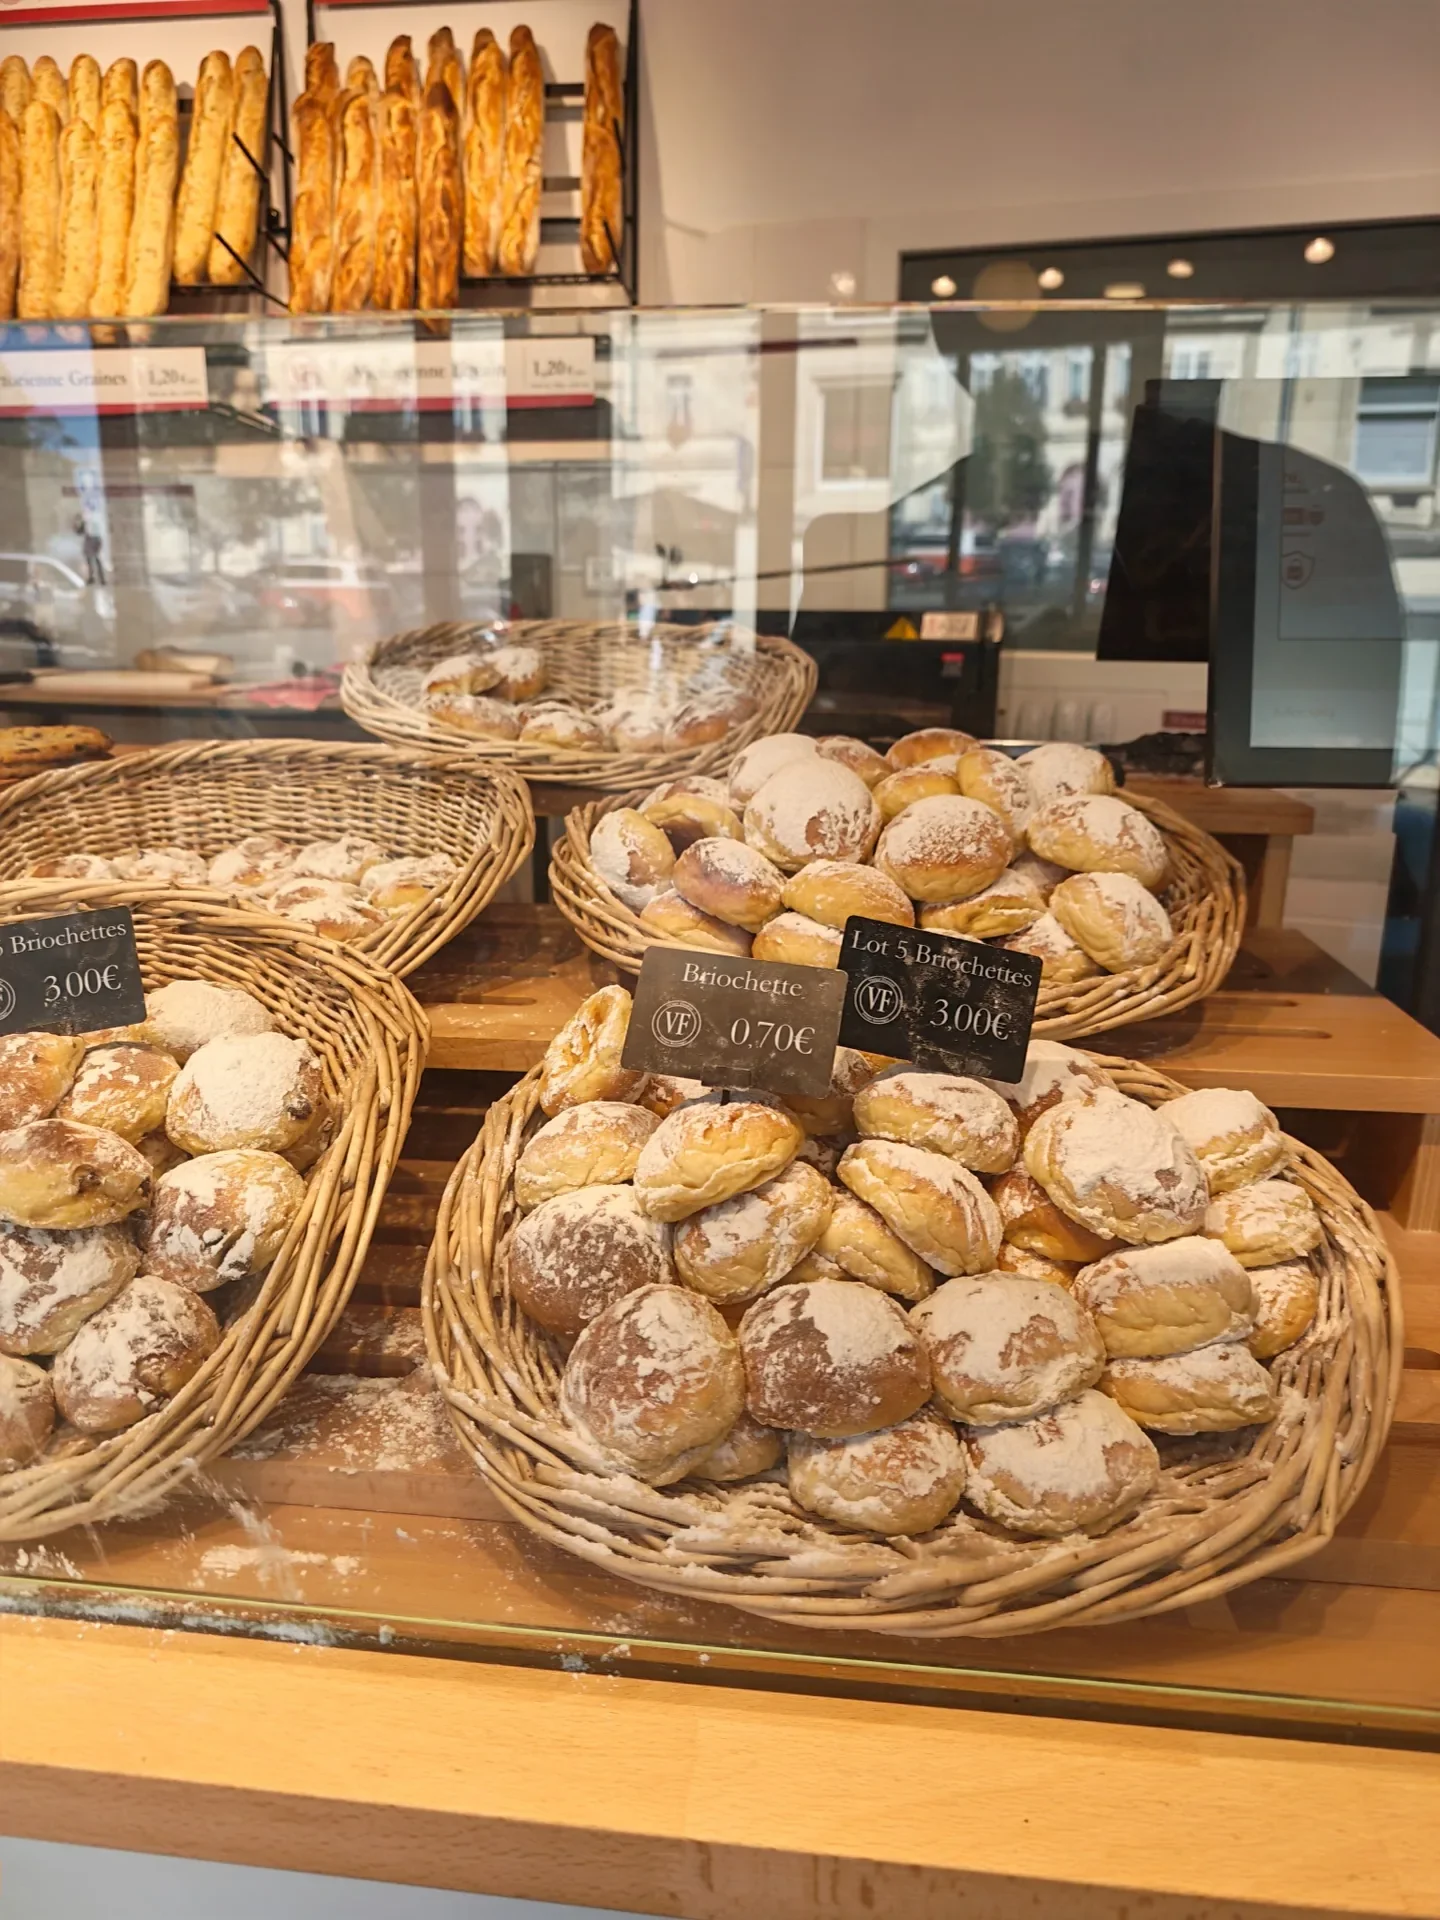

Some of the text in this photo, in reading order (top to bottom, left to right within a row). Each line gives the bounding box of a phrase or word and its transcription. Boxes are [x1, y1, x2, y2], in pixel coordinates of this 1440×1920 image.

[9, 923, 127, 955] Briochettes
[851, 930, 1033, 988] Lot 5 Briochettes
[43, 964, 122, 1003] 3,00€
[681, 962, 803, 997] Briochette
[867, 985, 893, 1013] VF
[665, 1010, 691, 1036] VF
[730, 1017, 816, 1055] 0,70€
[930, 998, 1012, 1041] 3,00€
